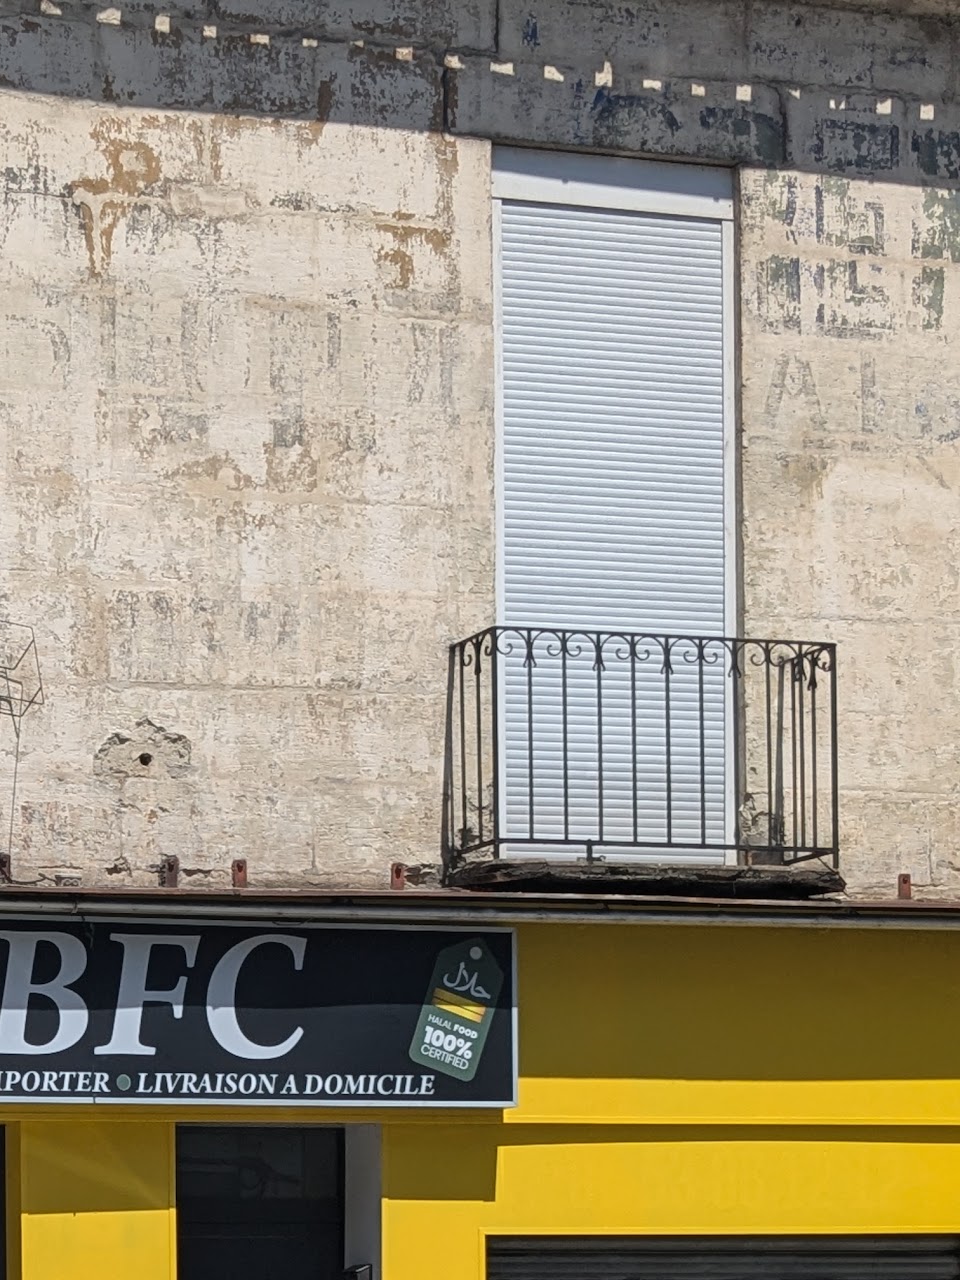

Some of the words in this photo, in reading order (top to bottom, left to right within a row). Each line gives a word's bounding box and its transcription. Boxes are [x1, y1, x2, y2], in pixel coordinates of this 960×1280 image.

[443, 961, 491, 1000] حلال
[427, 1014, 452, 1030] HALAL
[452, 1022, 478, 1038] FOOD
[424, 1026, 473, 1059] 100%
[420, 1044, 469, 1070] CERTIFIED
[136, 1072, 278, 1095] LIVRAISON
[279, 1073, 299, 1095] A
[305, 1074, 435, 1096] DOMICILE
